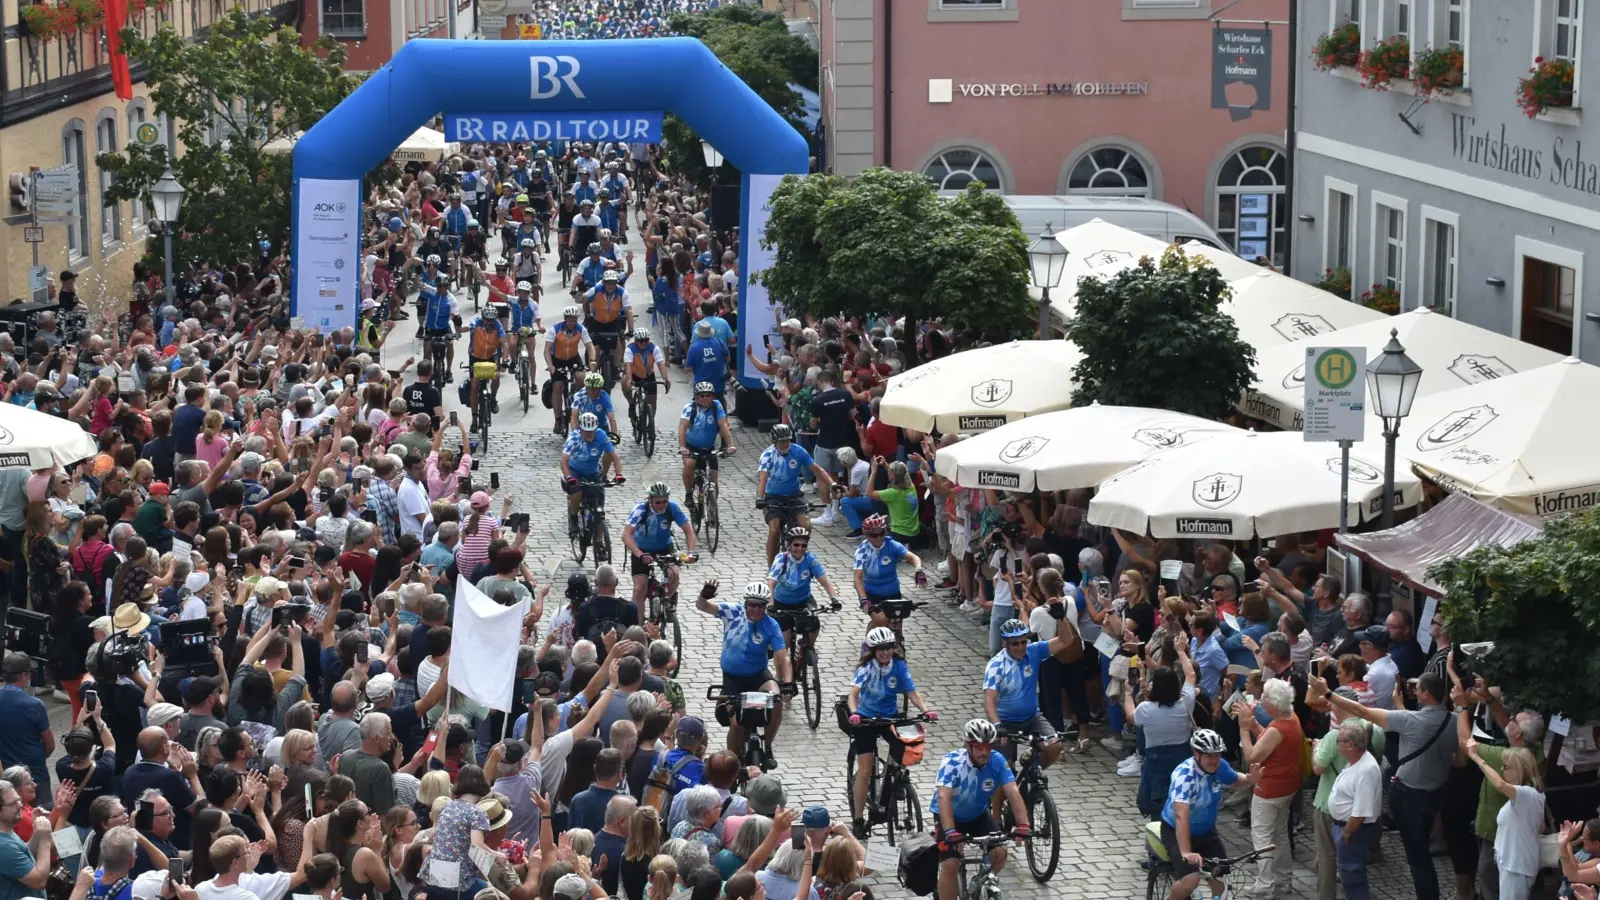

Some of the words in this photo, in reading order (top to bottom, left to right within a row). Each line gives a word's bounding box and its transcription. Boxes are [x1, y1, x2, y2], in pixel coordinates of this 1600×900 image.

[1223, 33, 1261, 43] Wirtshaus
[1218, 44, 1250, 54] Scharfes
[1251, 45, 1265, 55] Eck
[1225, 65, 1257, 75] Hofmann
[529, 55, 586, 100] BR
[959, 83, 996, 97] VON
[1000, 83, 1043, 97] POLL
[1047, 82, 1149, 96] IMMOBILIEN
[456, 117, 486, 141] BR
[493, 119, 650, 141] RADLTOUR
[391, 149, 425, 159] ofmann
[1450, 112, 1542, 180] Wirtshaus
[1550, 136, 1600, 196] Scha
[313, 203, 336, 212] AOK
[703, 347, 715, 356] BR
[412, 390, 423, 400] BR
[1318, 390, 1352, 398] Marktplatz
[1245, 391, 1281, 421] Hofmann
[961, 417, 1004, 428] Hofmann
[980, 472, 1018, 486] Hofmann
[1179, 519, 1230, 533] Hofmann
